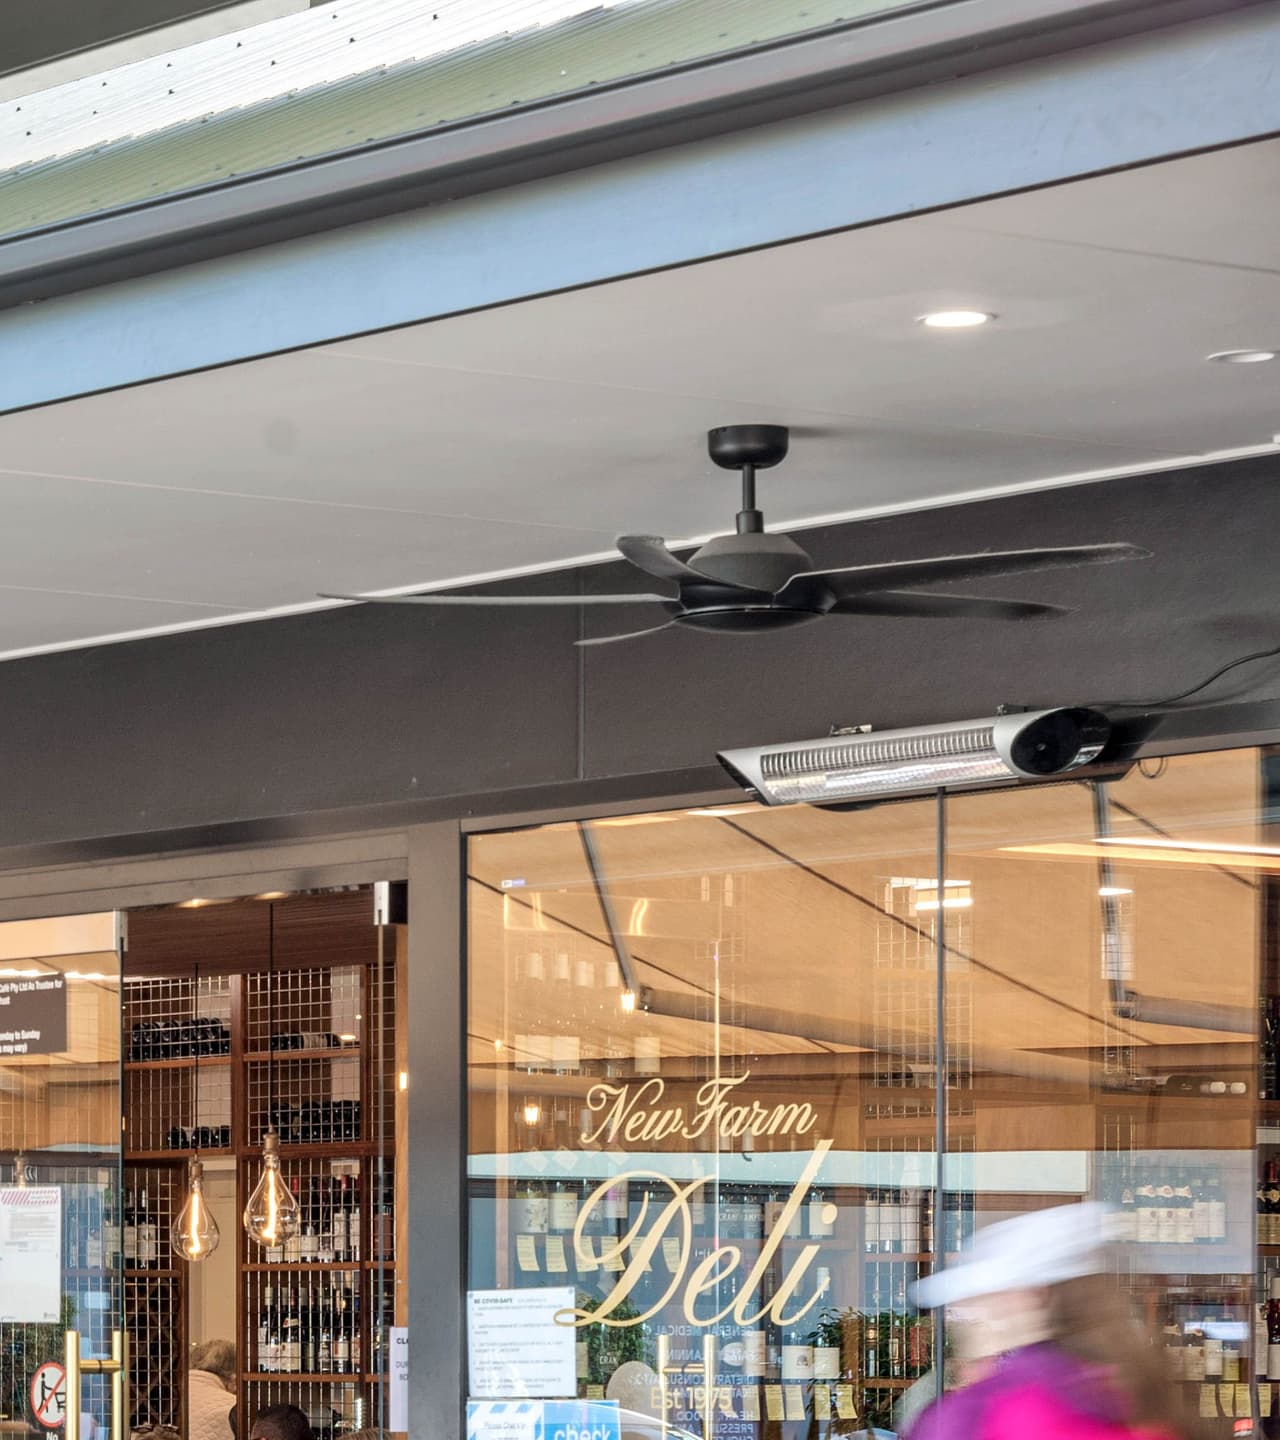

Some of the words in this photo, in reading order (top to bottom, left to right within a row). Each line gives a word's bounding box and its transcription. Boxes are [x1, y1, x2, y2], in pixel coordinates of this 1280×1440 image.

[580, 1078, 683, 1144] New
[680, 1070, 818, 1139] Farm
[553, 1138, 838, 1328] Deli
[650, 1386, 682, 1410] Est
